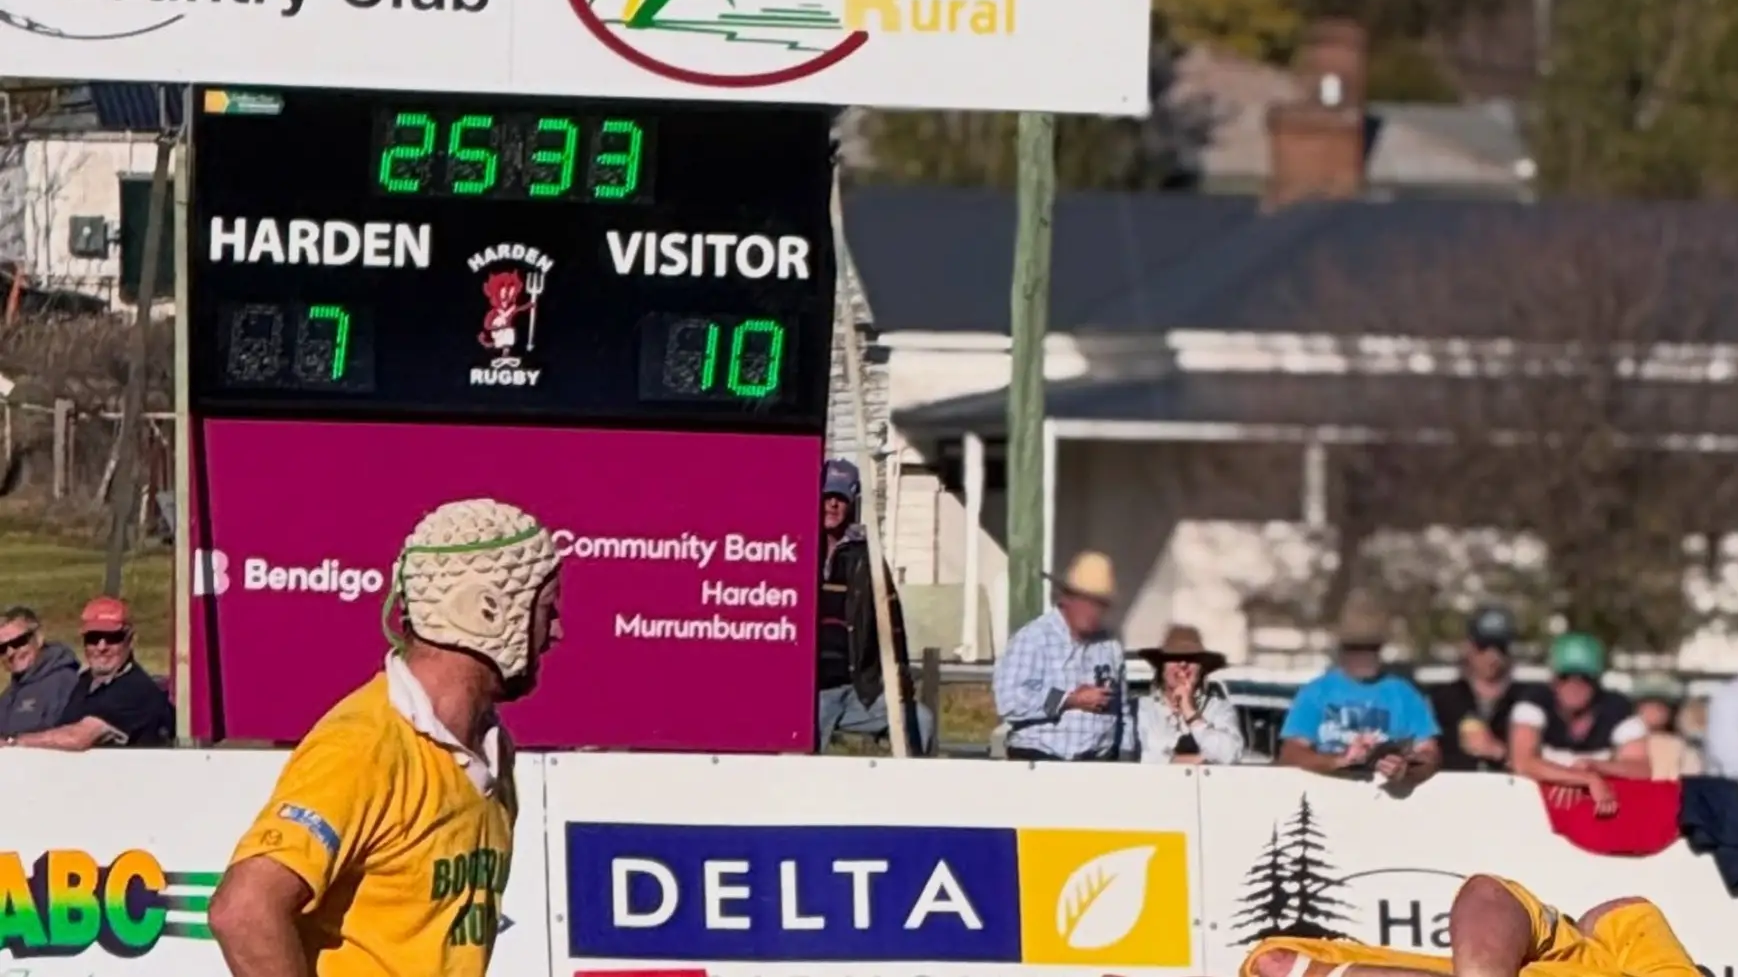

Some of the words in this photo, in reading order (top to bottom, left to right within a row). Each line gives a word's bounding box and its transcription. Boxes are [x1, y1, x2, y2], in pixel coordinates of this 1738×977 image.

[208, 217, 431, 269] HARDEN
[466, 242, 556, 273] HARDEN
[606, 229, 810, 280] VISITOR
[308, 305, 350, 382] 7
[700, 319, 785, 398] 10
[469, 367, 542, 387] RUGBY
[551, 529, 718, 569] Community
[724, 533, 797, 563] Bank
[243, 557, 384, 602] Bendigo
[701, 579, 797, 608] Harden
[614, 612, 797, 641] Murrumburrah
[0, 849, 167, 958] ABC
[609, 856, 985, 931] DELTA
